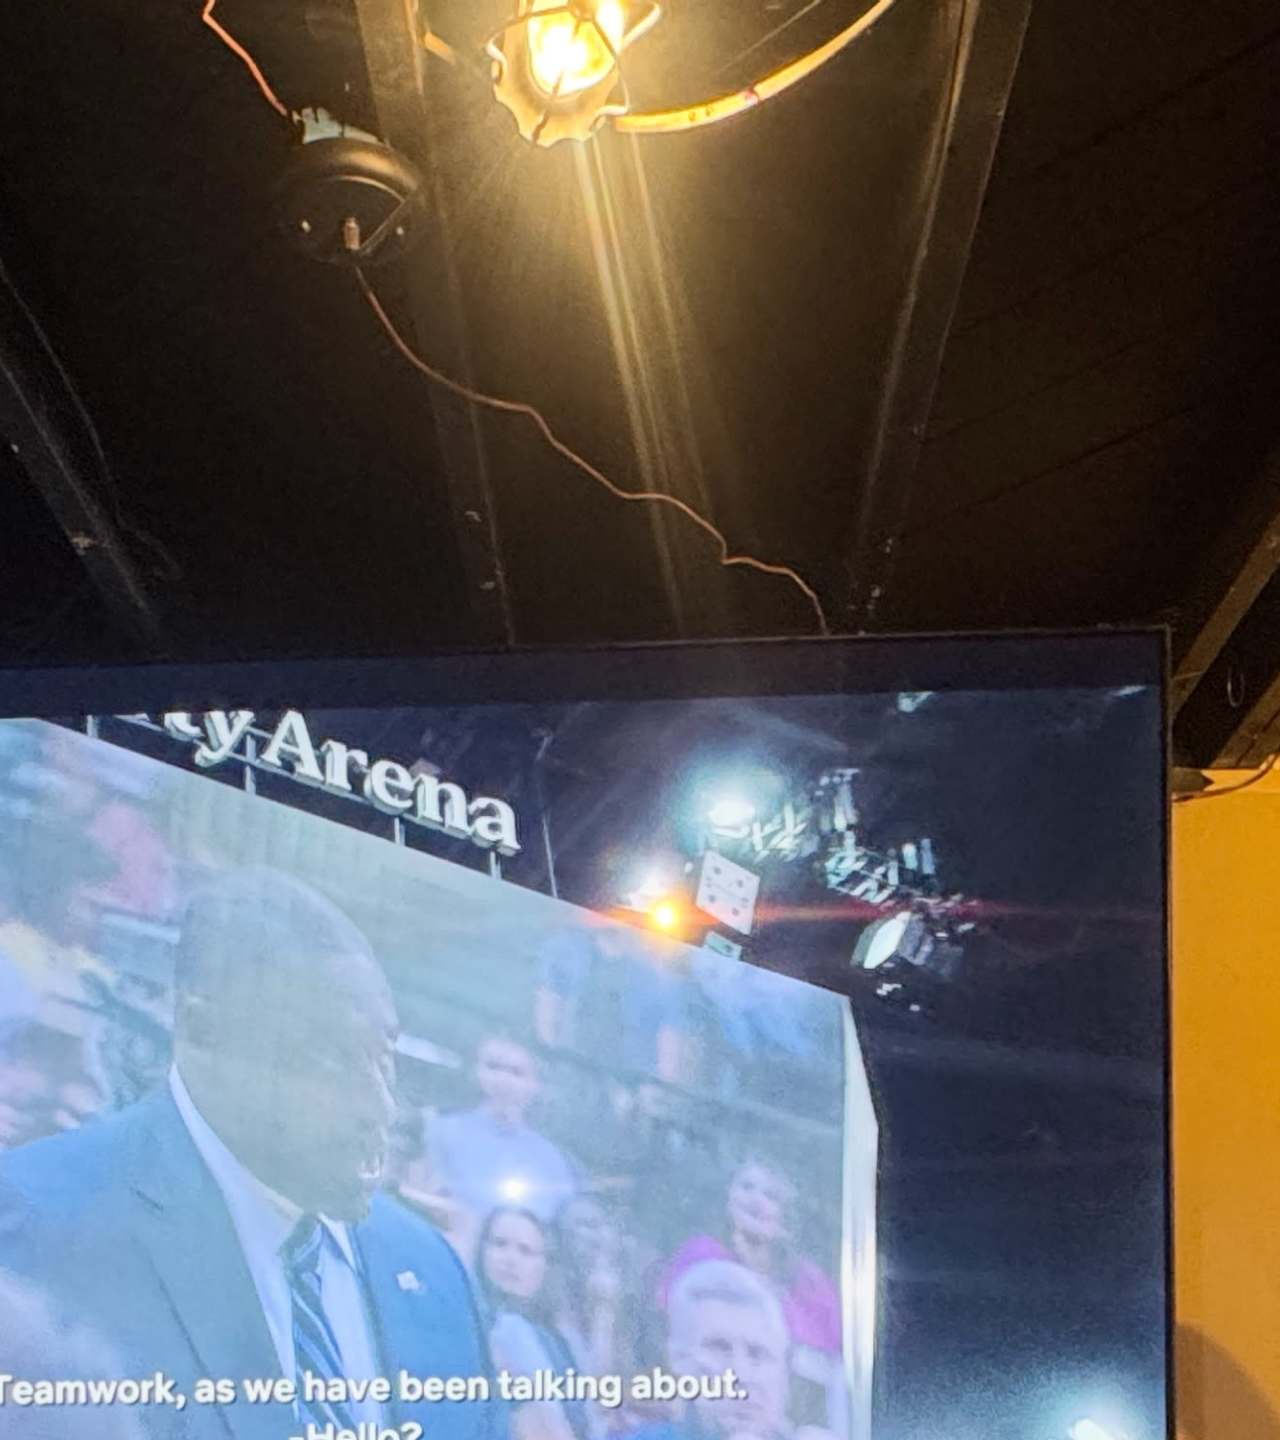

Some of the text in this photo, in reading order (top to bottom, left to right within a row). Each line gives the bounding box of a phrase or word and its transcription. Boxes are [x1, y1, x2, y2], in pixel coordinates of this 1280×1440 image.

[113, 708, 522, 856] ty Arena
[194, 1377, 236, 1404] as
[243, 1377, 297, 1403] we
[304, 1371, 391, 1403] have
[399, 1369, 490, 1402] been
[497, 1367, 623, 1408] talking
[630, 1366, 749, 1401] about.
